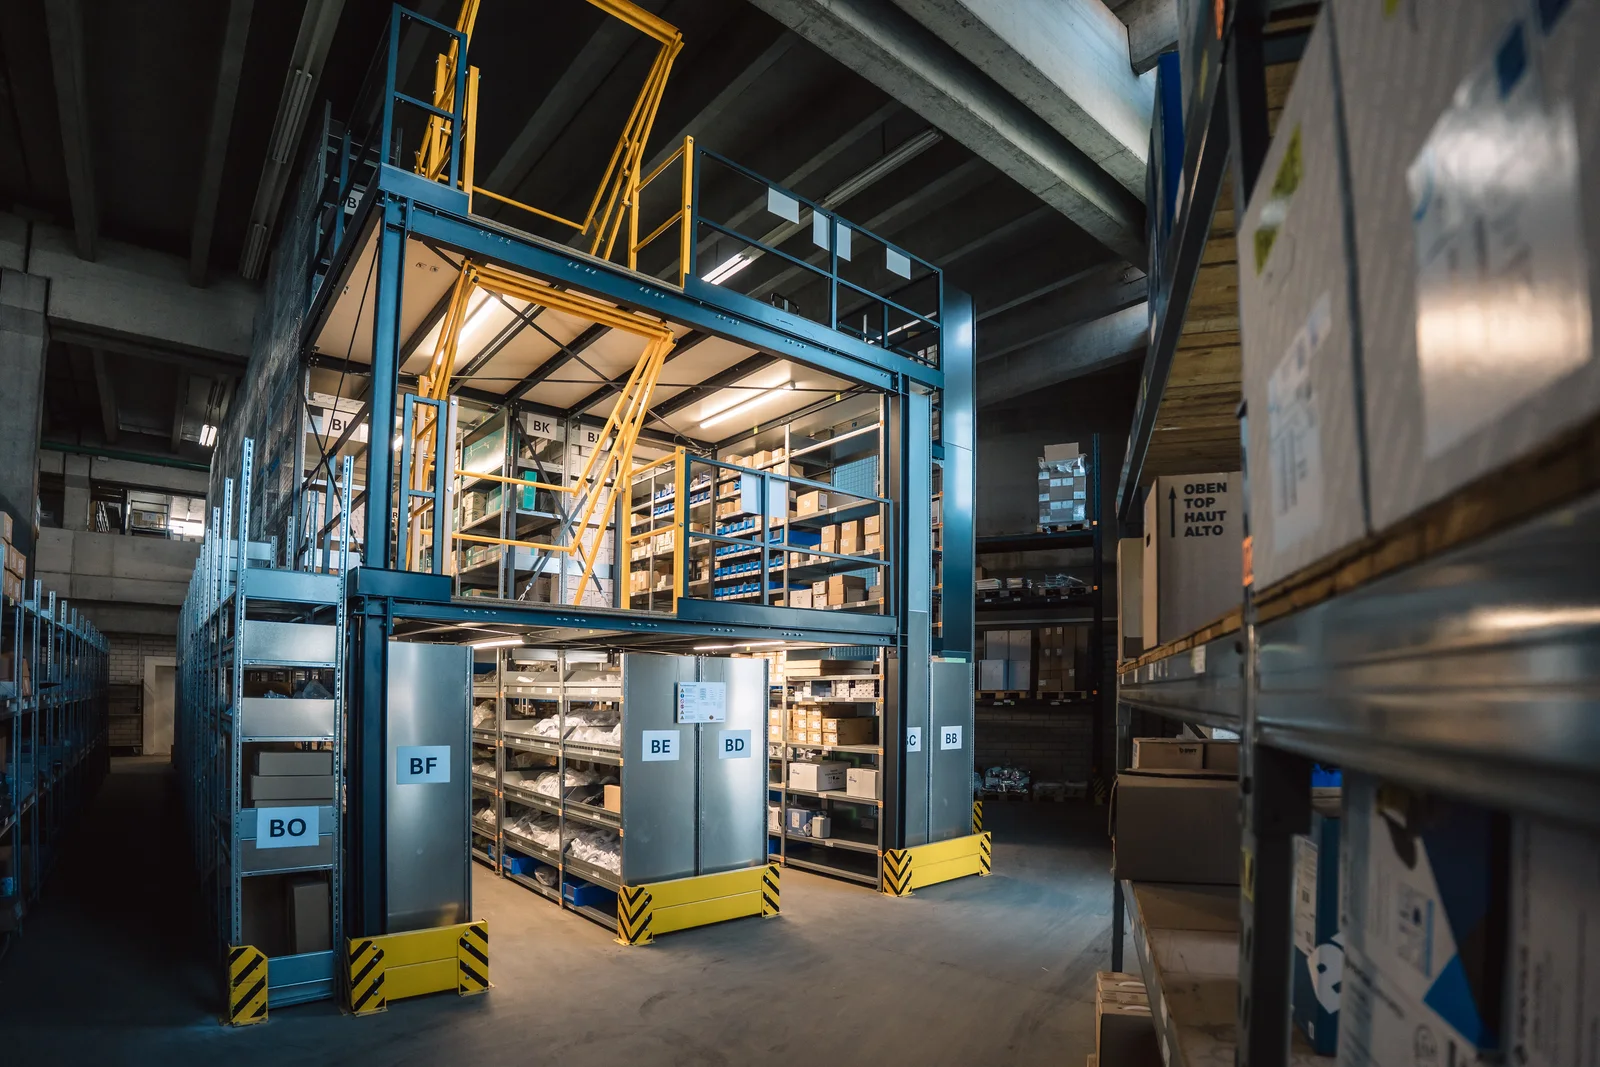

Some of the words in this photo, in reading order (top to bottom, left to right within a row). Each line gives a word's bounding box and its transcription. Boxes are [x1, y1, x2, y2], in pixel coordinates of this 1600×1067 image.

[533, 420, 550, 434] BK
[587, 431, 600, 443] BJ
[1184, 482, 1227, 495] OBEN
[1183, 497, 1216, 509] TOP
[1184, 510, 1227, 523] HAUT
[1184, 524, 1224, 537] ALTO
[725, 738, 745, 752] BD
[945, 733, 958, 744] BB
[651, 739, 671, 754] BE
[410, 757, 437, 775] BF
[269, 818, 307, 838] BO
